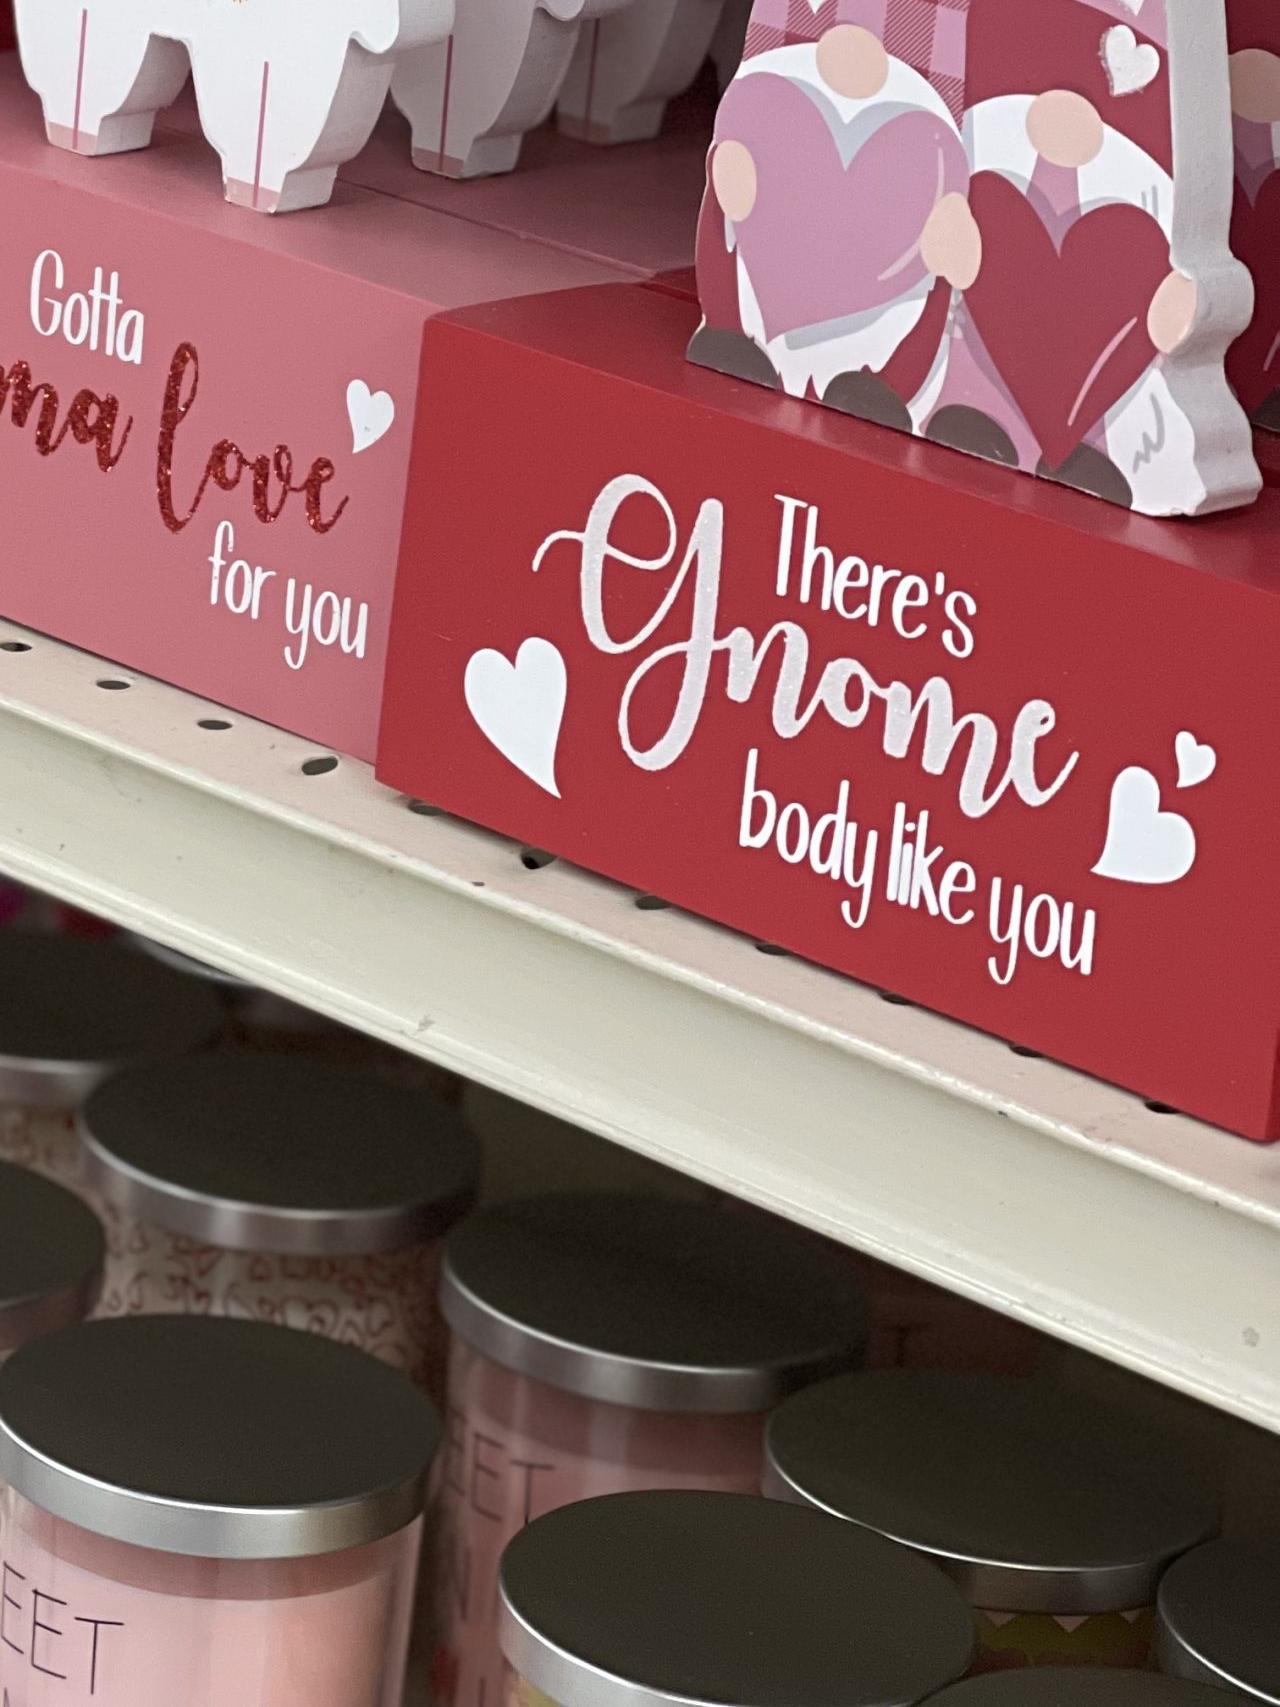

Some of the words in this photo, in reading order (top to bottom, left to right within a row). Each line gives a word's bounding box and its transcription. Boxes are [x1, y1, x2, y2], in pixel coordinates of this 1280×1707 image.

[30, 249, 144, 364] Gotta
[208, 521, 277, 619] for
[284, 577, 369, 669] you
[774, 495, 977, 657] There's
[739, 749, 878, 929] body
[886, 802, 976, 925] like
[988, 876, 1096, 985] you
[1, 1561, 124, 1695] EET
